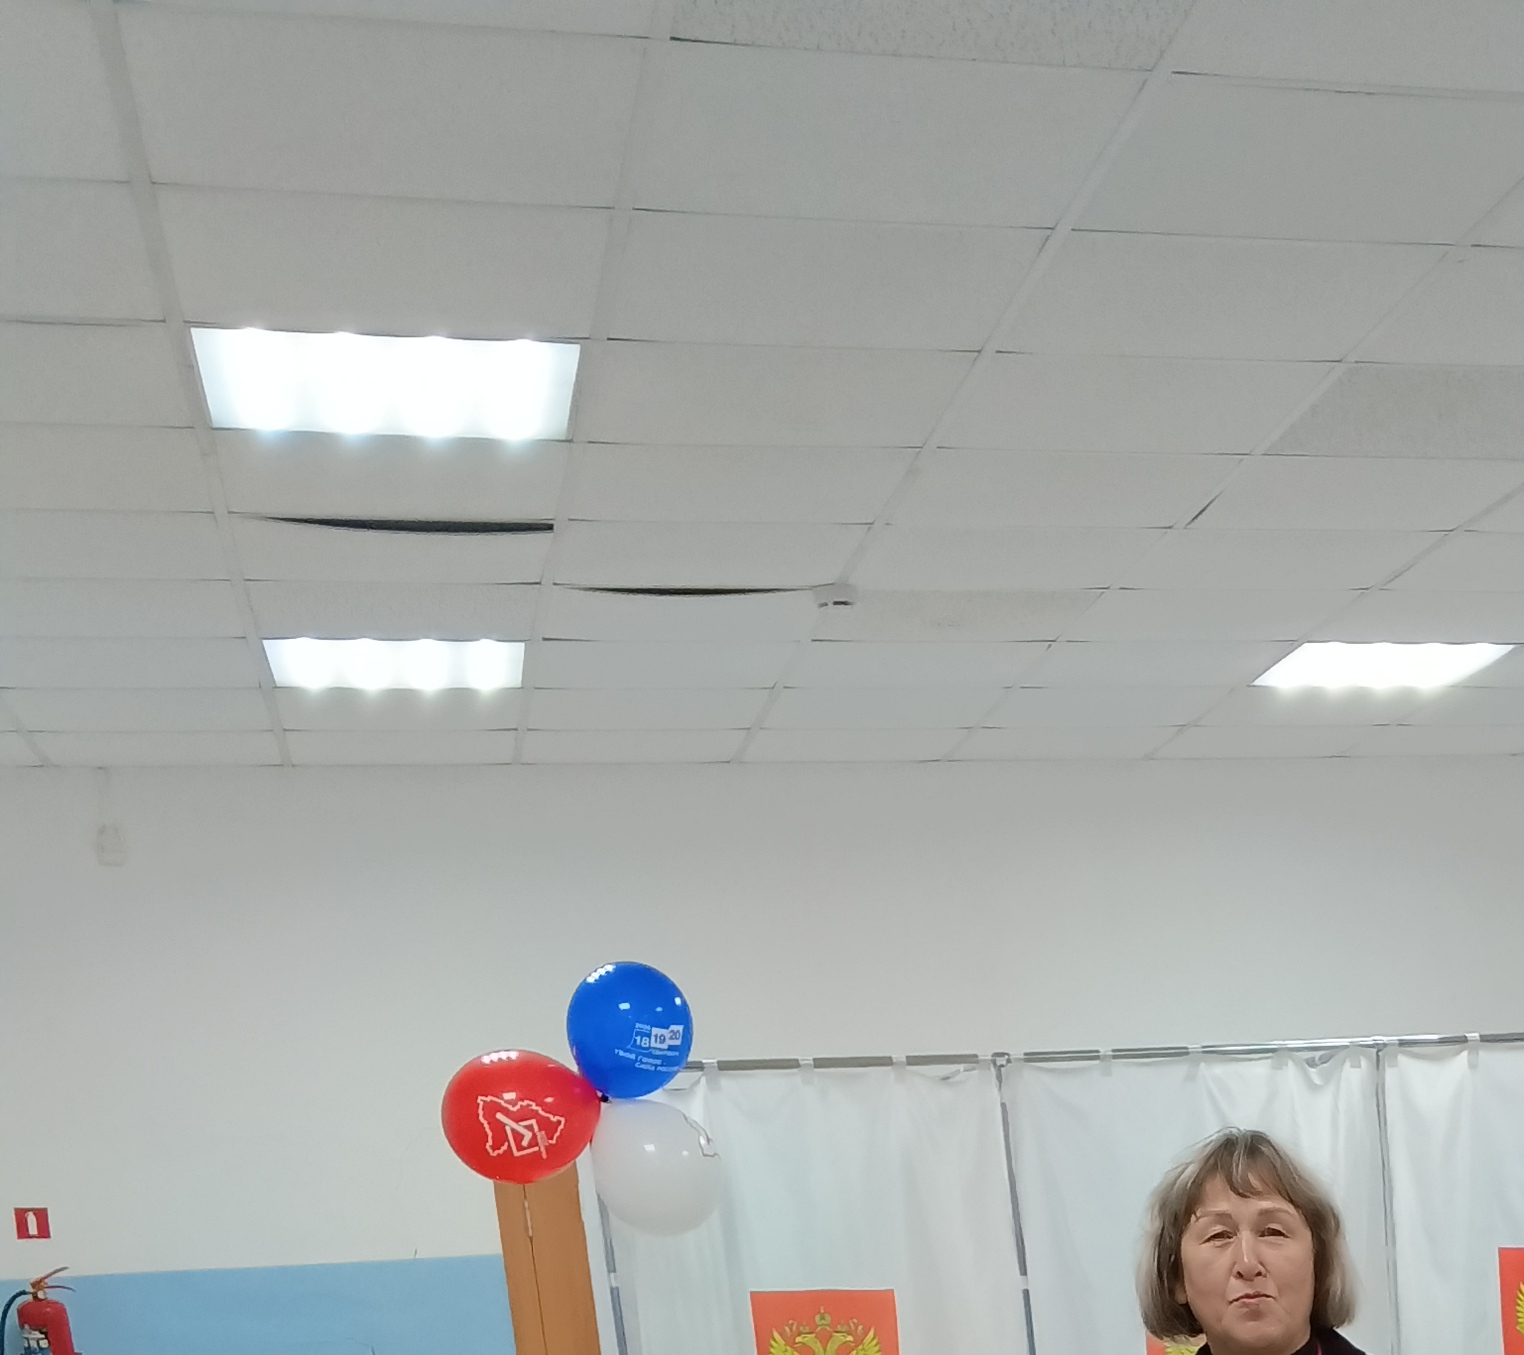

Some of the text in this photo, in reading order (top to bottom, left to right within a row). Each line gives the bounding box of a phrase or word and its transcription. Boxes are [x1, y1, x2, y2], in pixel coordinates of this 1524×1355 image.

[634, 1029, 681, 1048] 18 19 20
